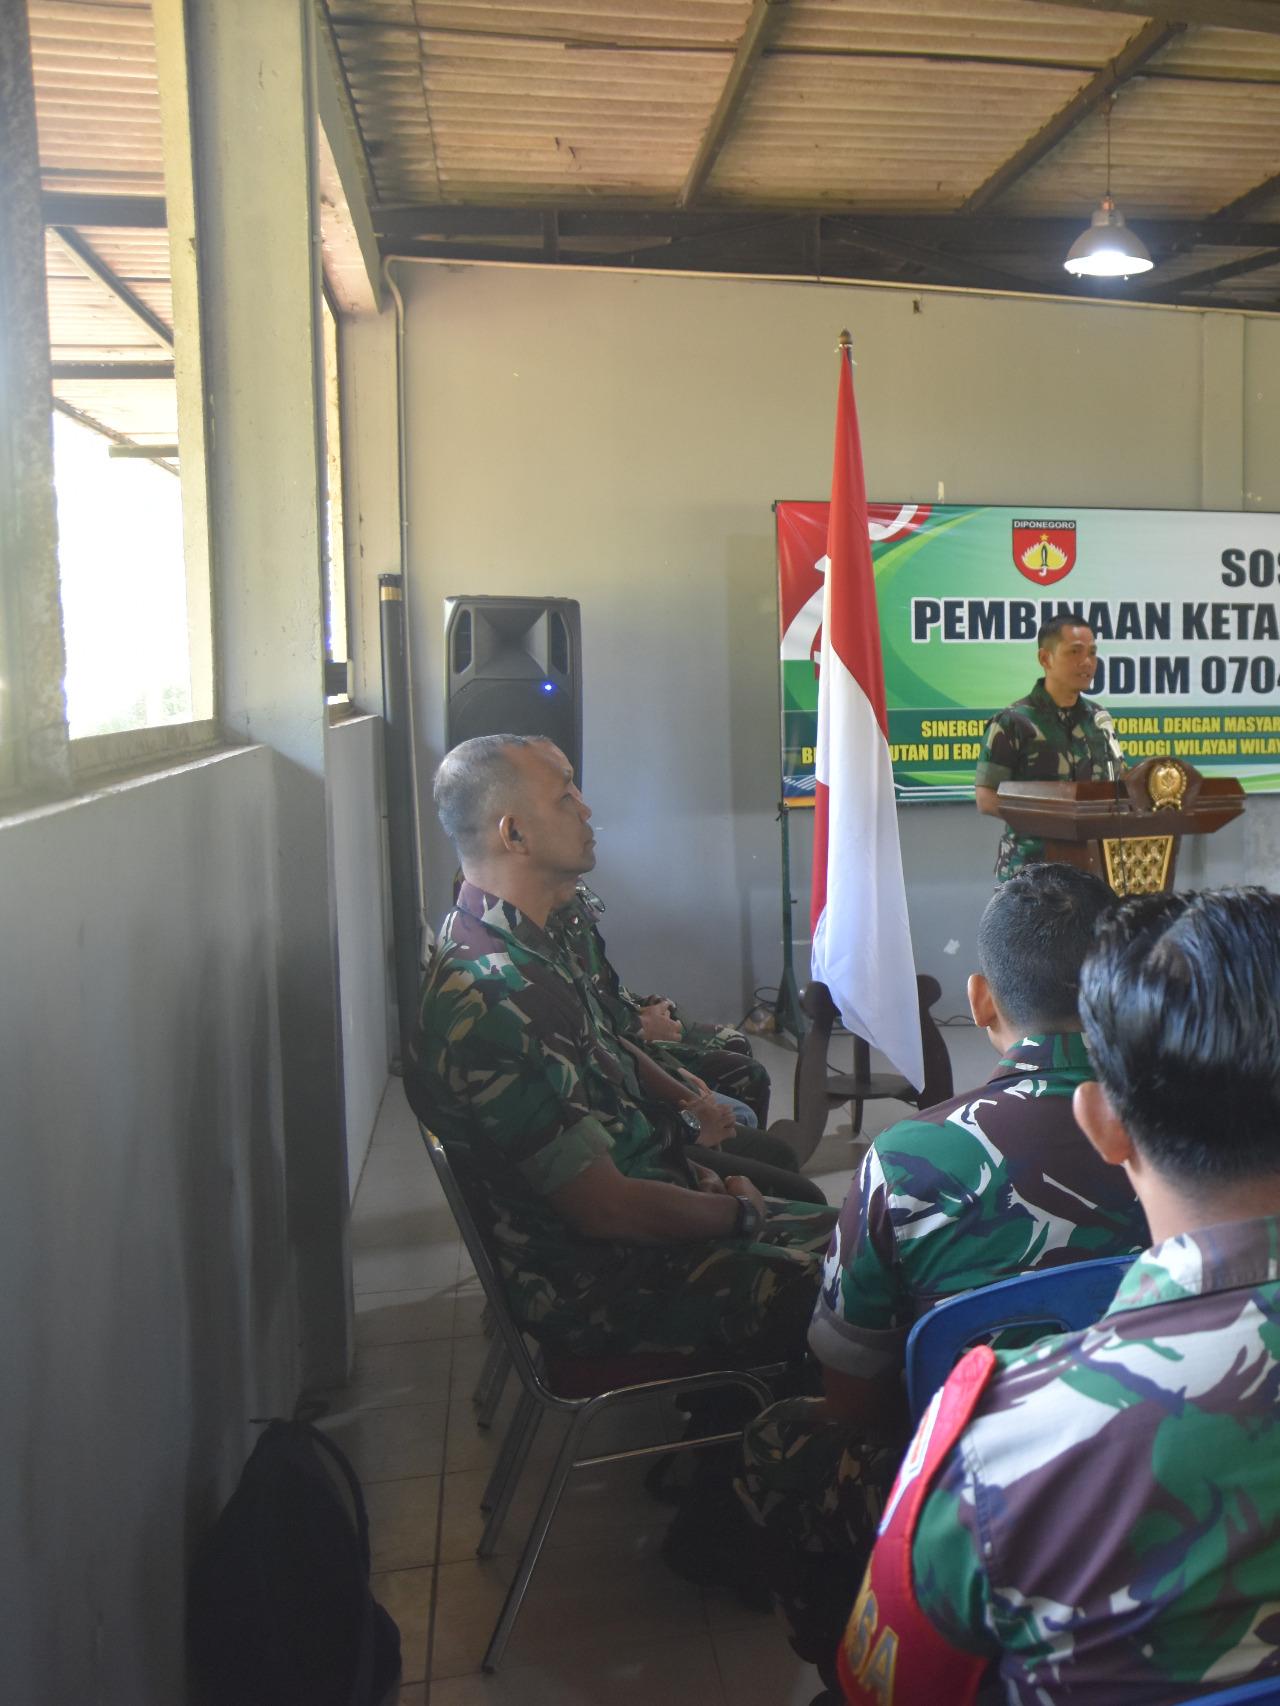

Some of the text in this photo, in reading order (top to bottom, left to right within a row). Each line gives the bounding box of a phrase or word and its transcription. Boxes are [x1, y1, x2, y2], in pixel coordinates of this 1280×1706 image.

[1013, 520, 1076, 530] DIPONEGORO
[1080, 655, 1190, 696] ODIM
[921, 719, 990, 738] SINERGI
[1111, 717, 1160, 734] TORIAL
[1163, 716, 1221, 733] DENGAN
[933, 743, 950, 760] DI
[1119, 739, 1171, 756] POLOGI
[1174, 739, 1237, 756] WILAYAH
